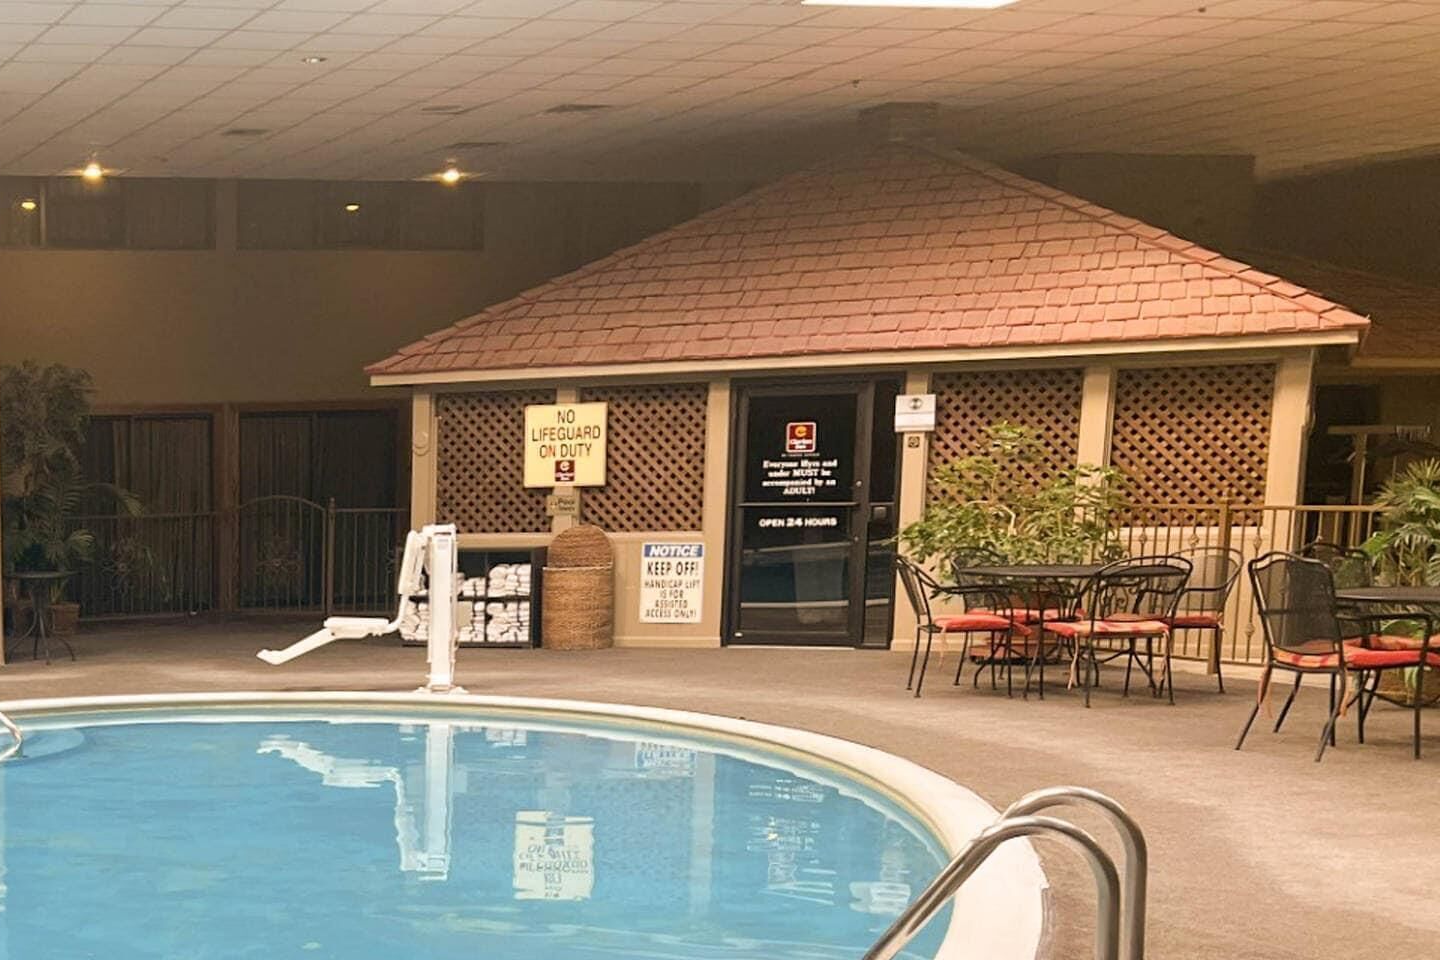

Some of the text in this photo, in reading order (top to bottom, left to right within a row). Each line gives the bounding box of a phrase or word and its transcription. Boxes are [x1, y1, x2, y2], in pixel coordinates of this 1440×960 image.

[557, 409, 575, 424] NO
[532, 425, 601, 441] LIFEGUARD
[540, 443, 592, 458] ON DUTY
[821, 459, 838, 467] and
[768, 469, 791, 478] under
[792, 469, 819, 477] MUST
[813, 478, 824, 487] by
[759, 517, 837, 527] OPEN 24 HOURS
[650, 545, 699, 557] NOTICE
[647, 561, 699, 576] KEEP OFF!
[644, 579, 700, 589] HANDICAP LIFT
[660, 589, 684, 599] IS FOR
[645, 609, 671, 618] ACCESS
